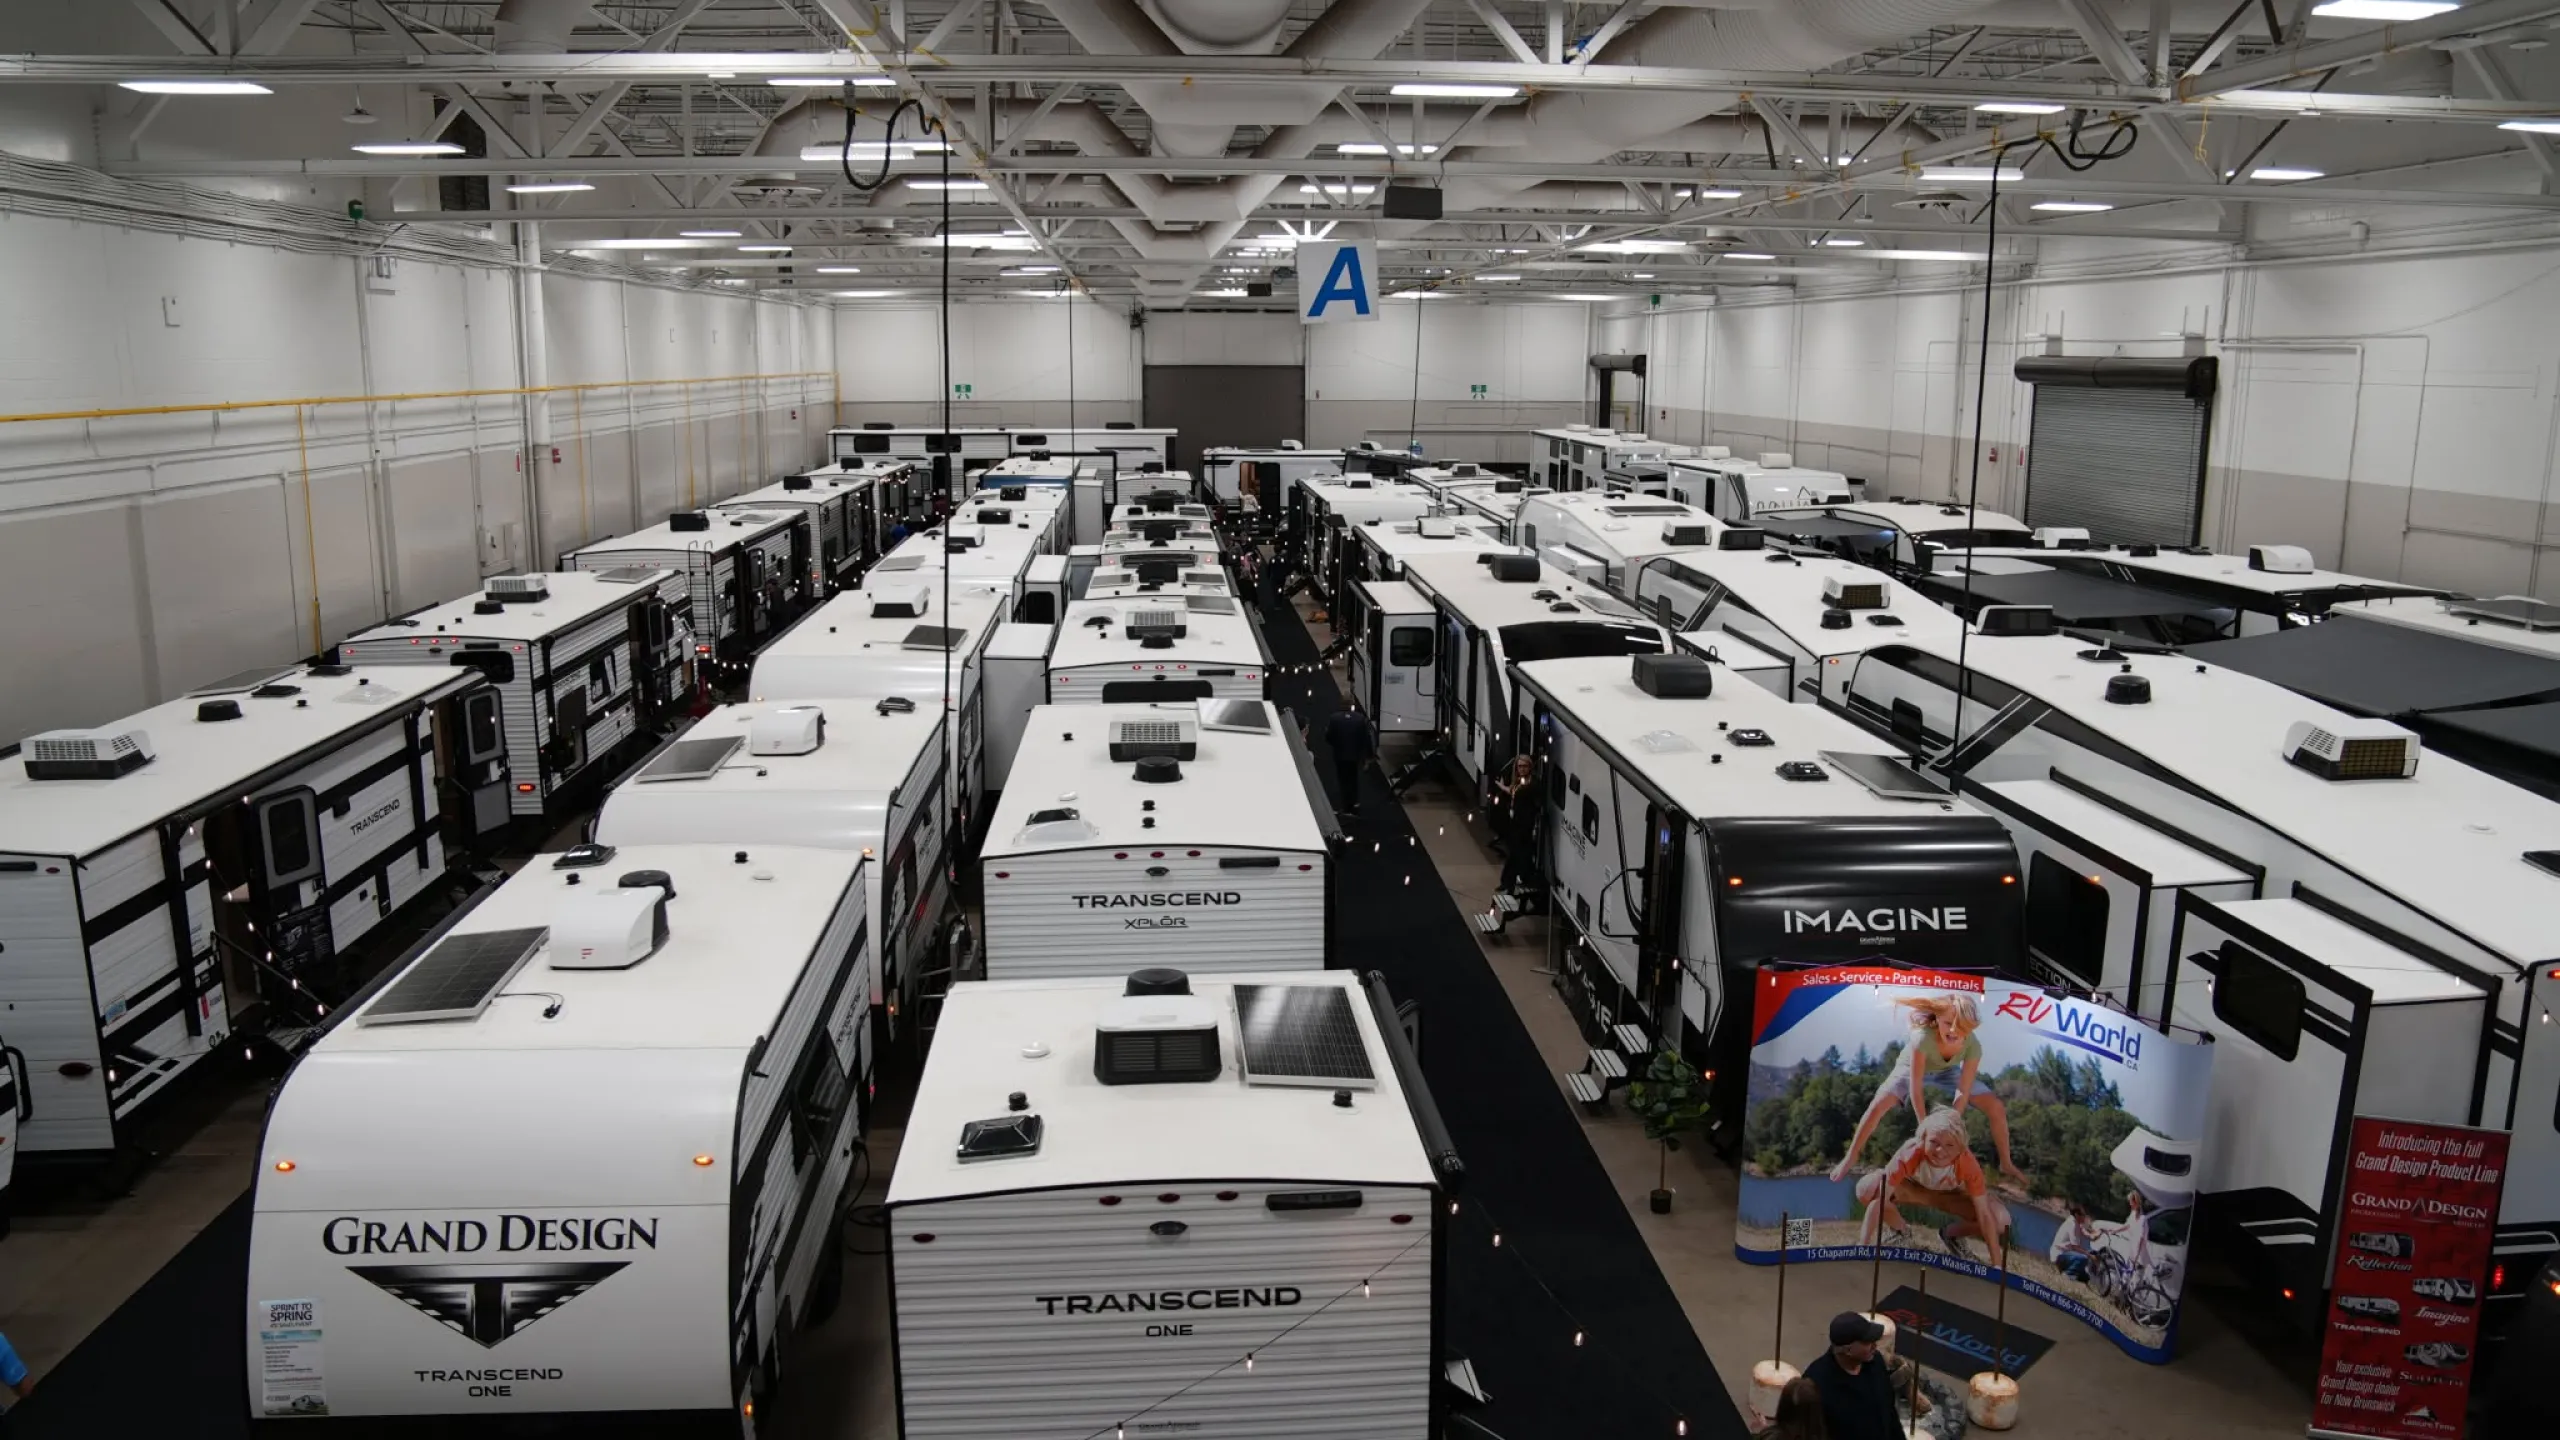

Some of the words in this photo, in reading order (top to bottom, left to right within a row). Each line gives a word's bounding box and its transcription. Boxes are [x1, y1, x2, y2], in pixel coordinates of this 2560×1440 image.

[1307, 246, 1371, 317] A
[350, 798, 400, 836] TRANSCEND
[1072, 892, 1241, 908] TRANSCEND
[1783, 907, 1967, 933] IMAGINE
[1802, 974, 1831, 986] Sales
[1839, 971, 1883, 983] Service
[1892, 972, 1923, 985] Parts
[1934, 975, 1980, 991] Rentals
[1994, 992, 2052, 1024] RV
[2056, 1003, 2141, 1061] World
[2377, 1130, 2442, 1156] Introducing
[2442, 1138, 2462, 1156] the
[2463, 1140, 2485, 1158] full
[2355, 1151, 2390, 1172] Grand
[2389, 1155, 2428, 1177] Design
[2428, 1159, 2474, 1181] Product
[2474, 1165, 2499, 1183] Line
[2352, 1192, 2411, 1210] GRAND
[2428, 1200, 2488, 1219] DESIGN
[322, 1216, 487, 1255] GRAND
[498, 1214, 660, 1251] DESIGN
[1807, 1249, 1816, 1260] 15
[1818, 1247, 1857, 1260] Chaparral
[1859, 1247, 1871, 1258] Rd,
[1894, 1248, 1900, 1258] 2
[1904, 1249, 1920, 1260] Exit
[1922, 1252, 1938, 1264] 297
[1941, 1256, 1972, 1274] Waasis,
[1974, 1264, 1987, 1276] NB
[2022, 1280, 2035, 1293] Toll
[2035, 1285, 2050, 1299] Free
[270, 1304, 299, 1312] SPRINT
[301, 1303, 312, 1311] TO
[1035, 1287, 1301, 1315] TRANSCEND
[270, 1311, 312, 1322] SPRING
[2415, 1306, 2470, 1327] Imagine
[1146, 1324, 1193, 1337] ONE
[414, 1368, 563, 1382] TRANSCEND
[2335, 1360, 2352, 1373] Your
[468, 1385, 512, 1397] ONE
[2333, 1393, 2353, 1408] New
